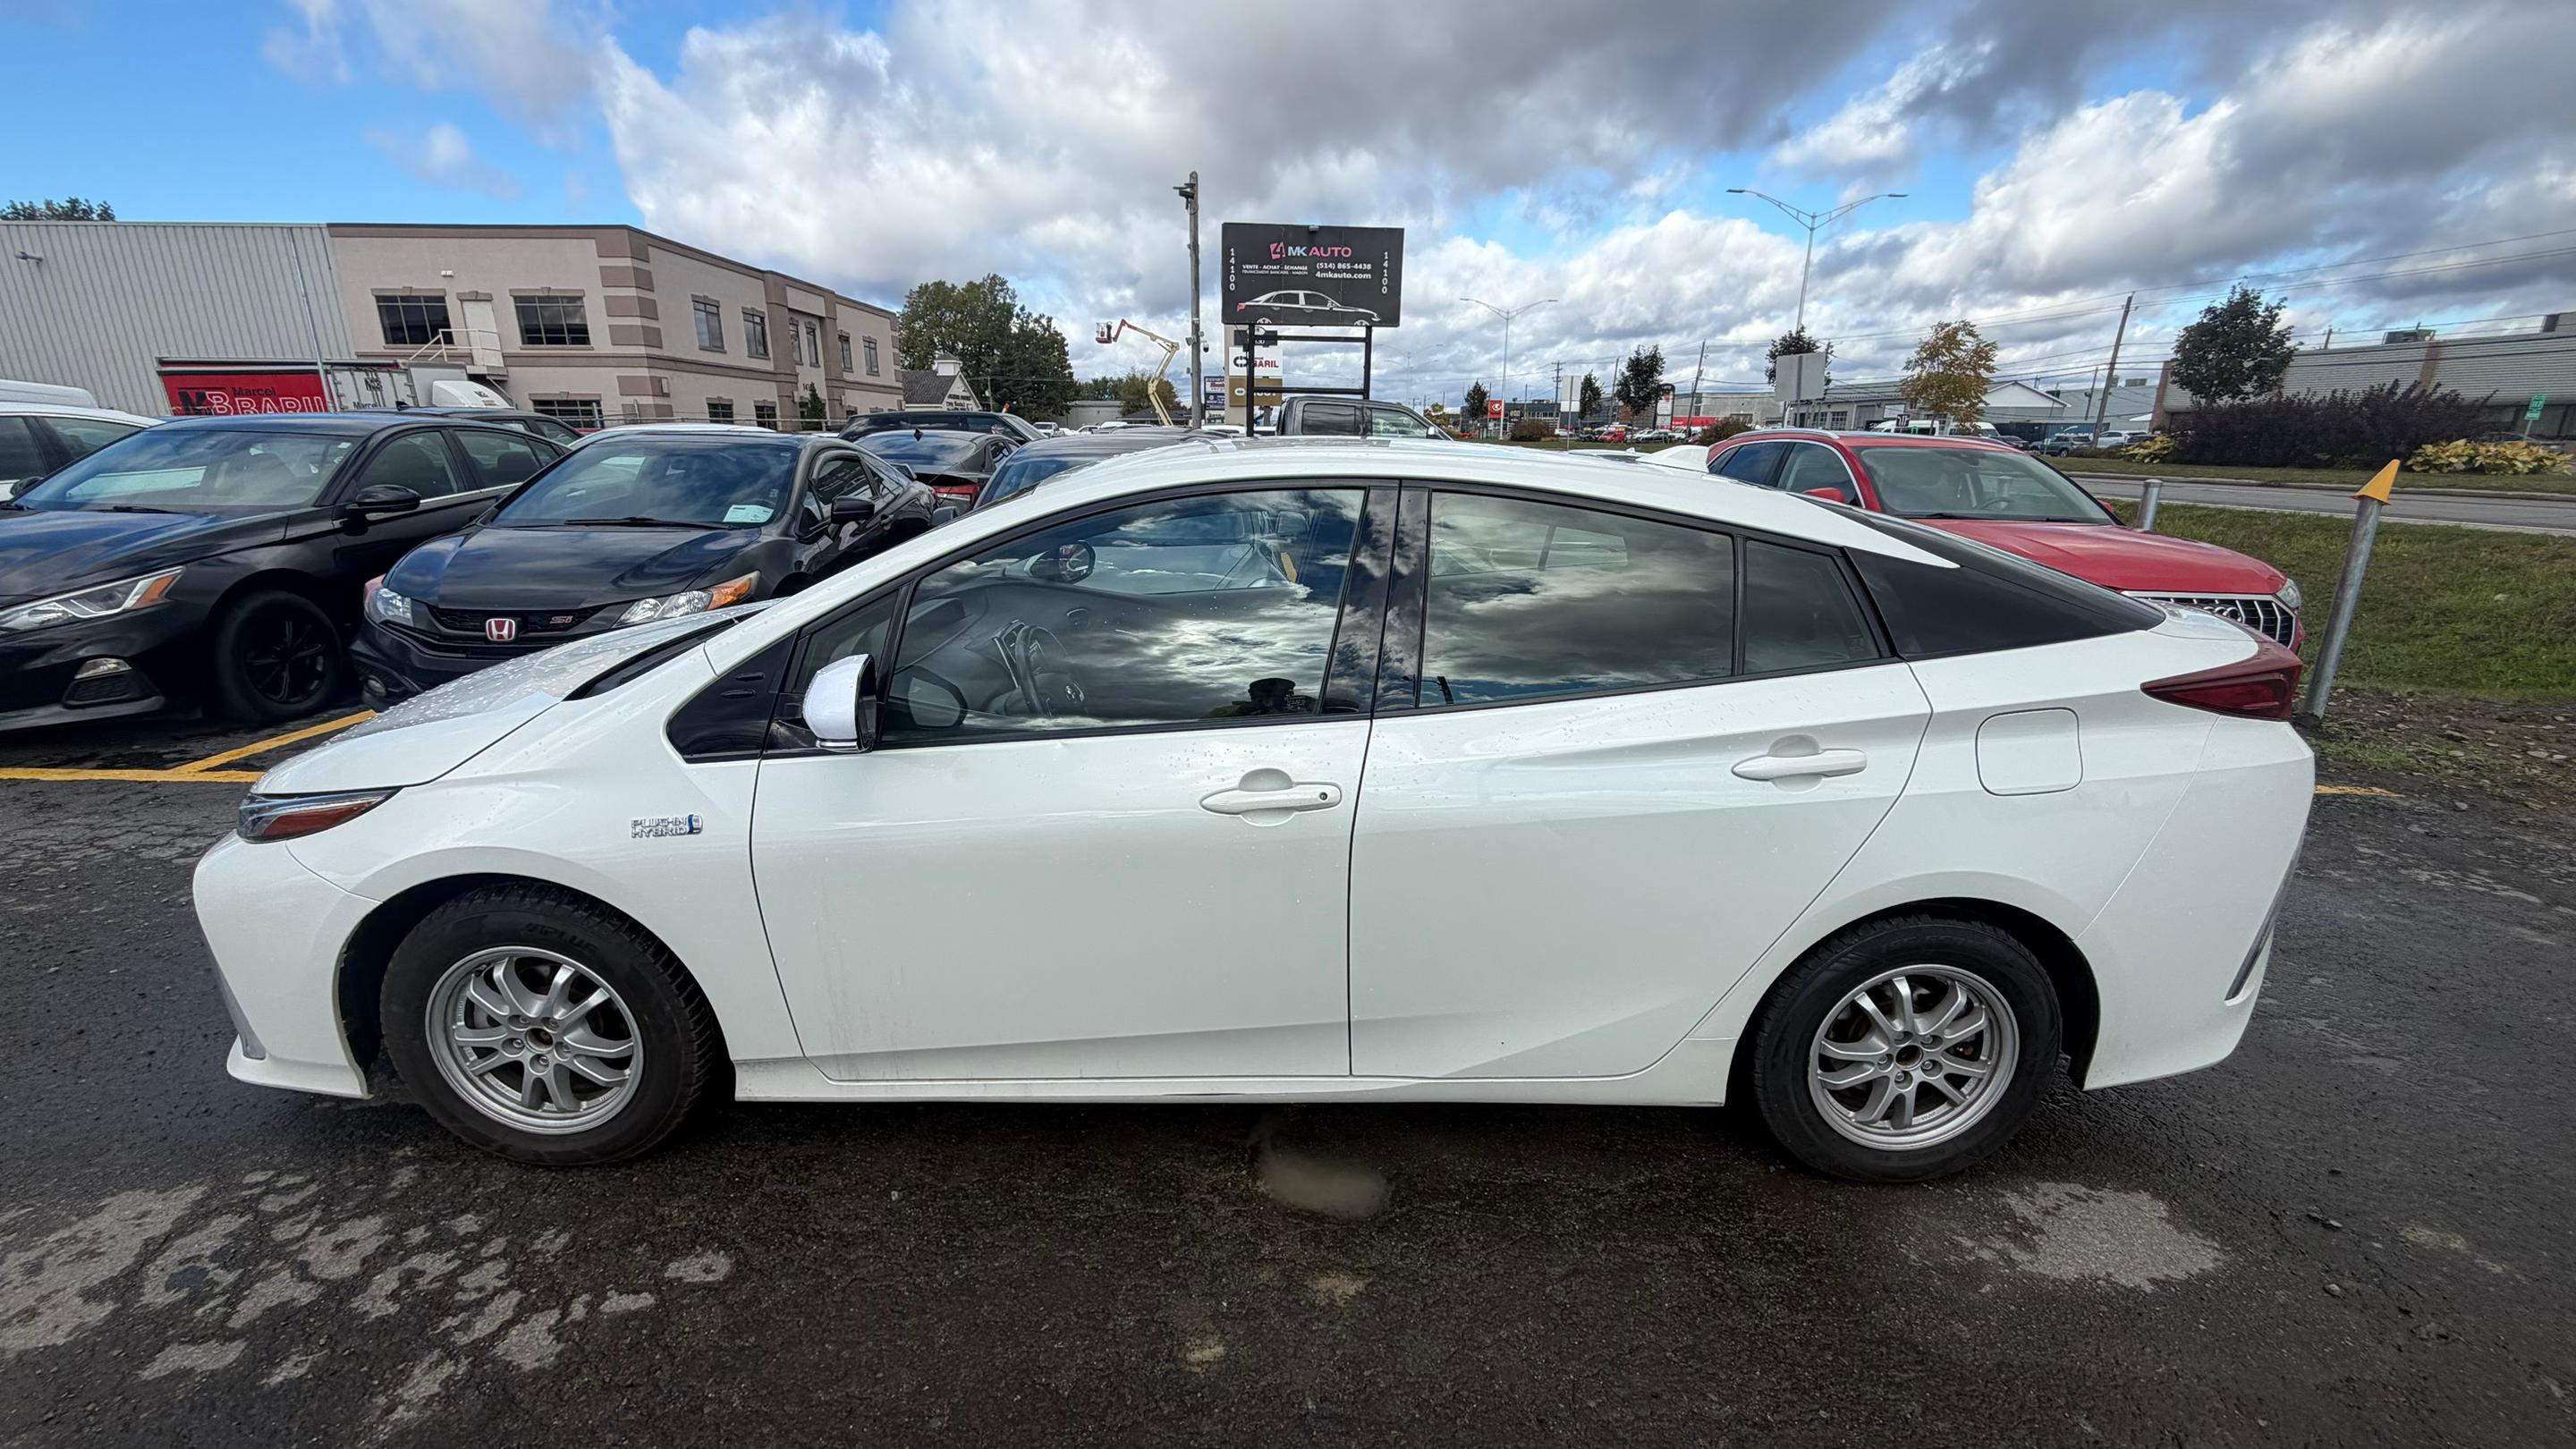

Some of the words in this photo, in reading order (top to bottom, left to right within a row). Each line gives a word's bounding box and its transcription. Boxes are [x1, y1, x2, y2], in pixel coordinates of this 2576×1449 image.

[1288, 246, 1307, 257] MK
[1308, 246, 1352, 258] AUTO
[1316, 262, 1335, 270] (514)
[1337, 262, 1372, 270] 865-4438
[1315, 271, 1372, 279] 4mkauto.com
[232, 386, 276, 397] Marcel
[631, 816, 688, 829] PLUG-IN
[631, 826, 688, 839] HYBRID
